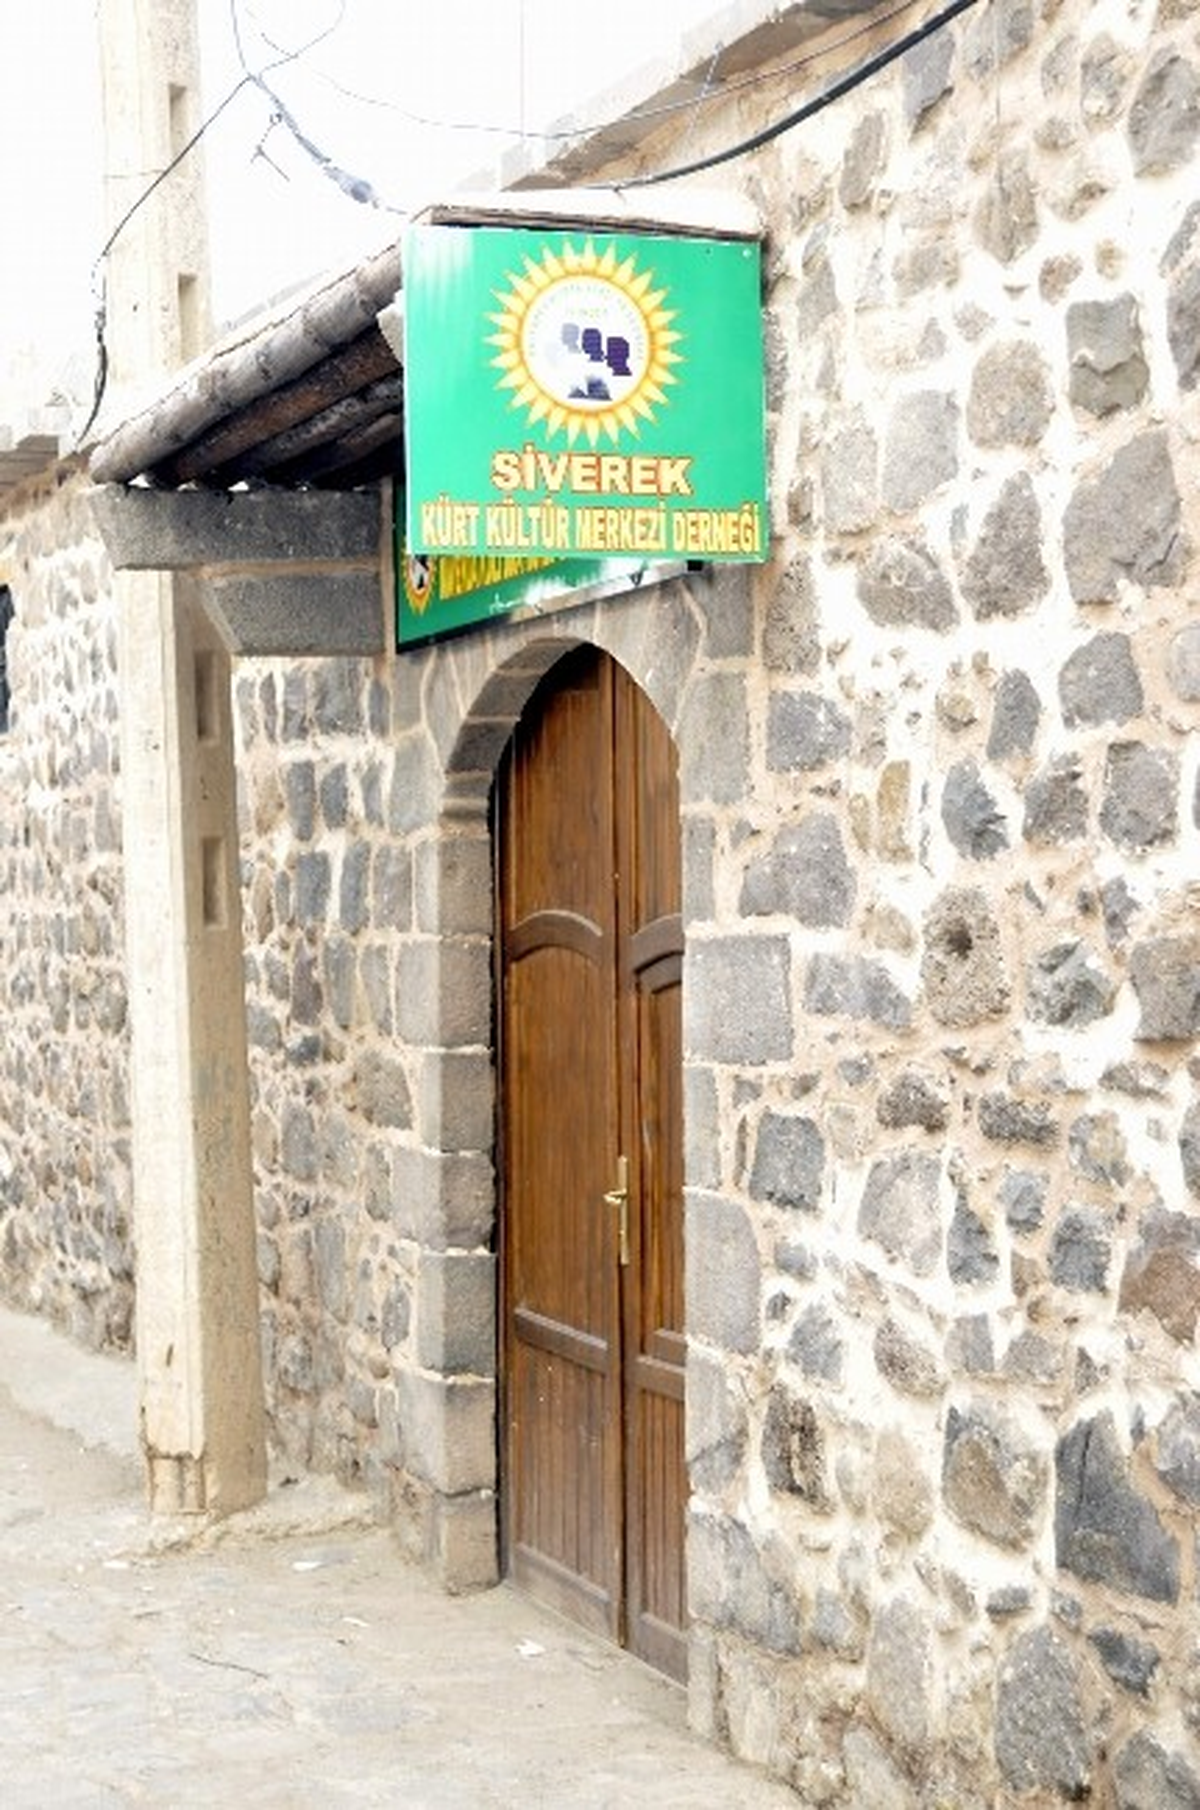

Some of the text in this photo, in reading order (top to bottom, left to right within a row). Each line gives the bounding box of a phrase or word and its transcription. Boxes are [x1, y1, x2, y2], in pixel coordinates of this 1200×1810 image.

[490, 443, 693, 495] SİVEREK
[421, 494, 761, 554] KÜRT KÜLTÜR MERKEZİ DERNEĞİ
